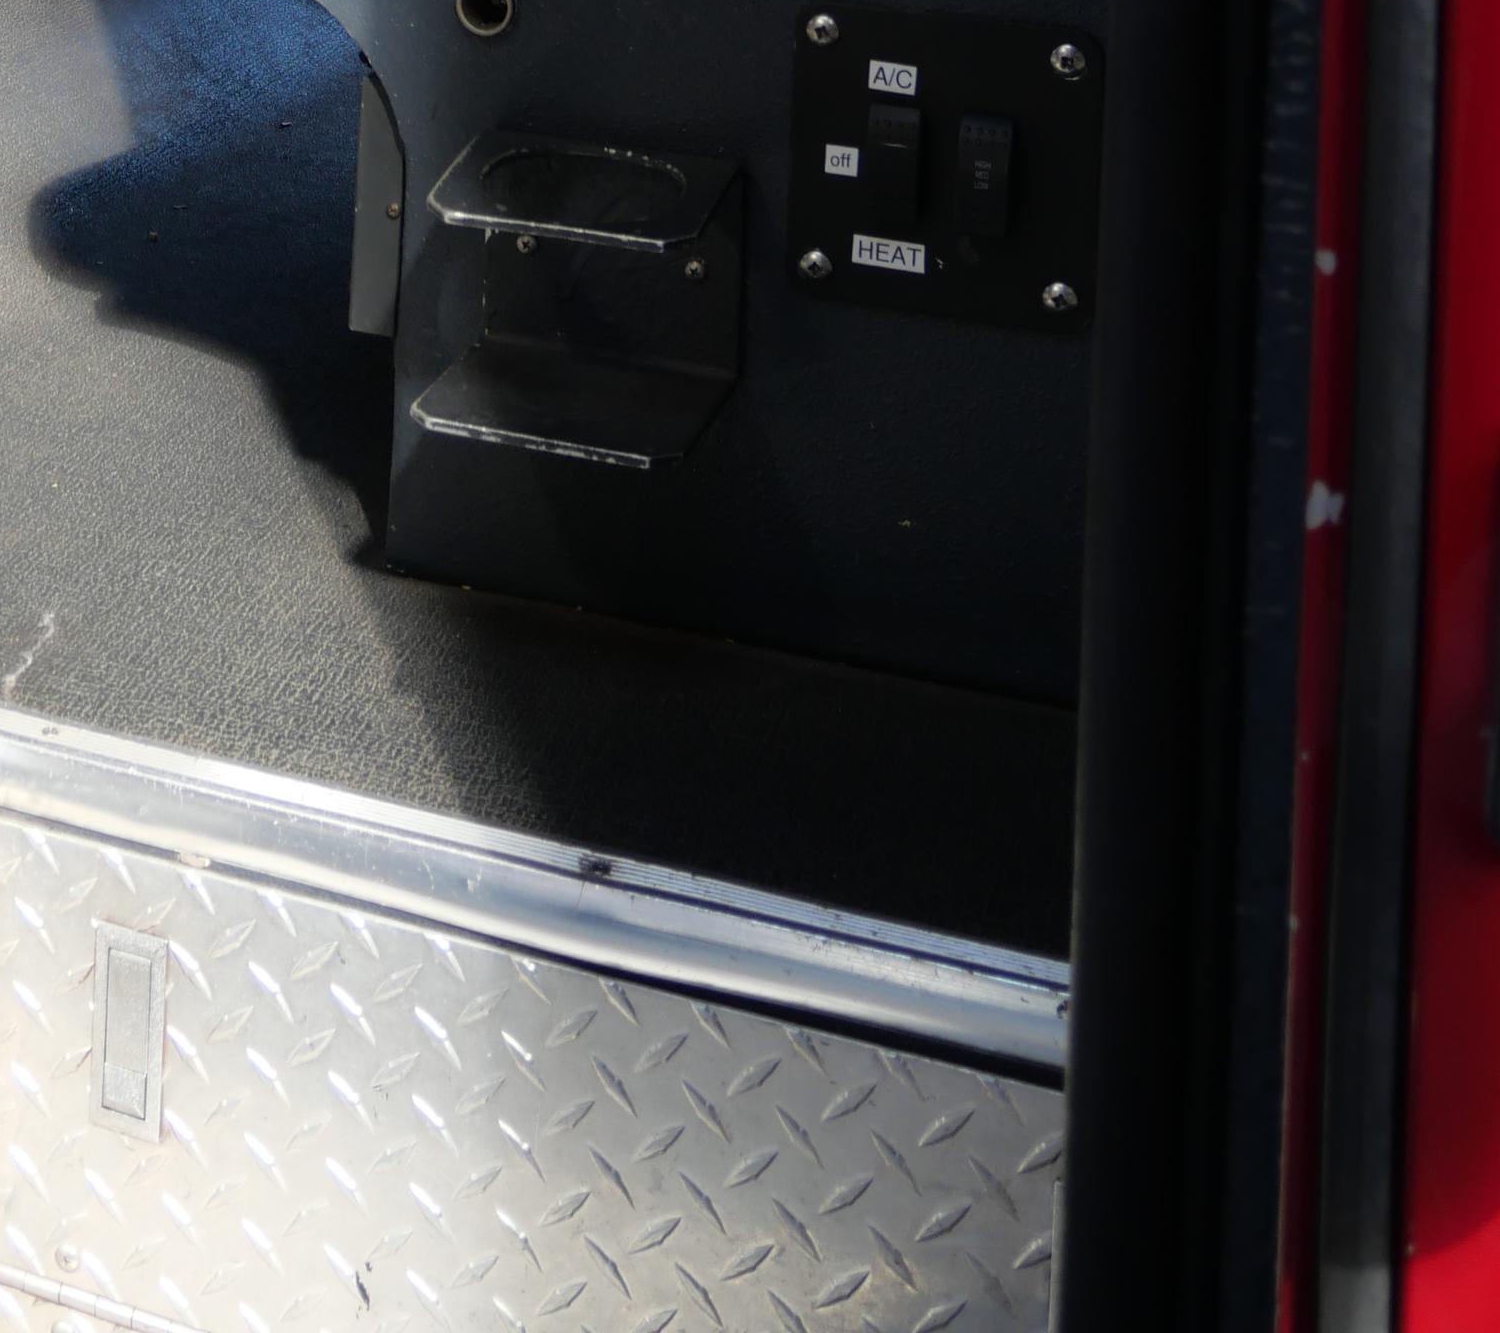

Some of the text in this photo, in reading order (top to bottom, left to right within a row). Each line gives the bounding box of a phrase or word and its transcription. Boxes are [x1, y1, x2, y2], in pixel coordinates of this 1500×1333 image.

[873, 66, 912, 89] A/C
[830, 153, 851, 168] off
[858, 240, 922, 267] HEAT
